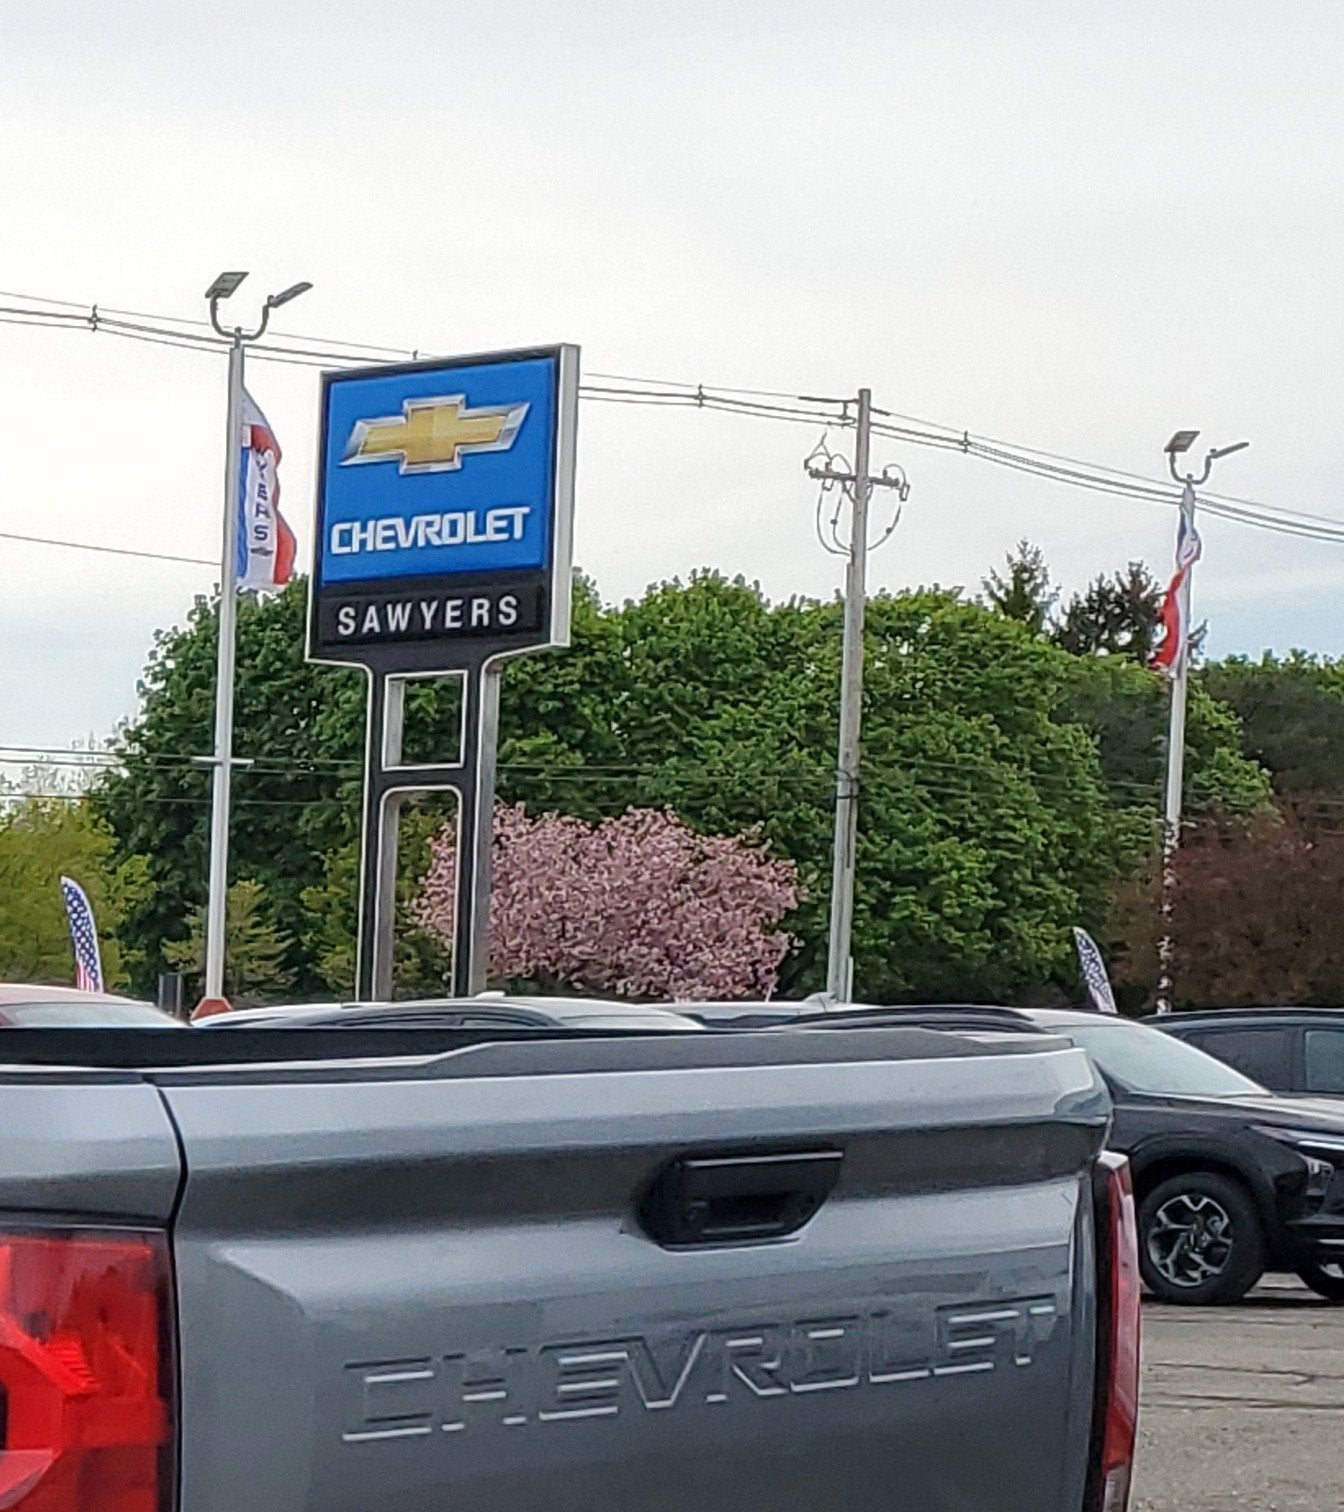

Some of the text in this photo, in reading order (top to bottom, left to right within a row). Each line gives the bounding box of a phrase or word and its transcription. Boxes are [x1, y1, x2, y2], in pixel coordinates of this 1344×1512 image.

[330, 507, 530, 554] CHEVROLET
[338, 596, 518, 635] SAWYERS
[342, 1294, 1057, 1442] CHEVROLET
